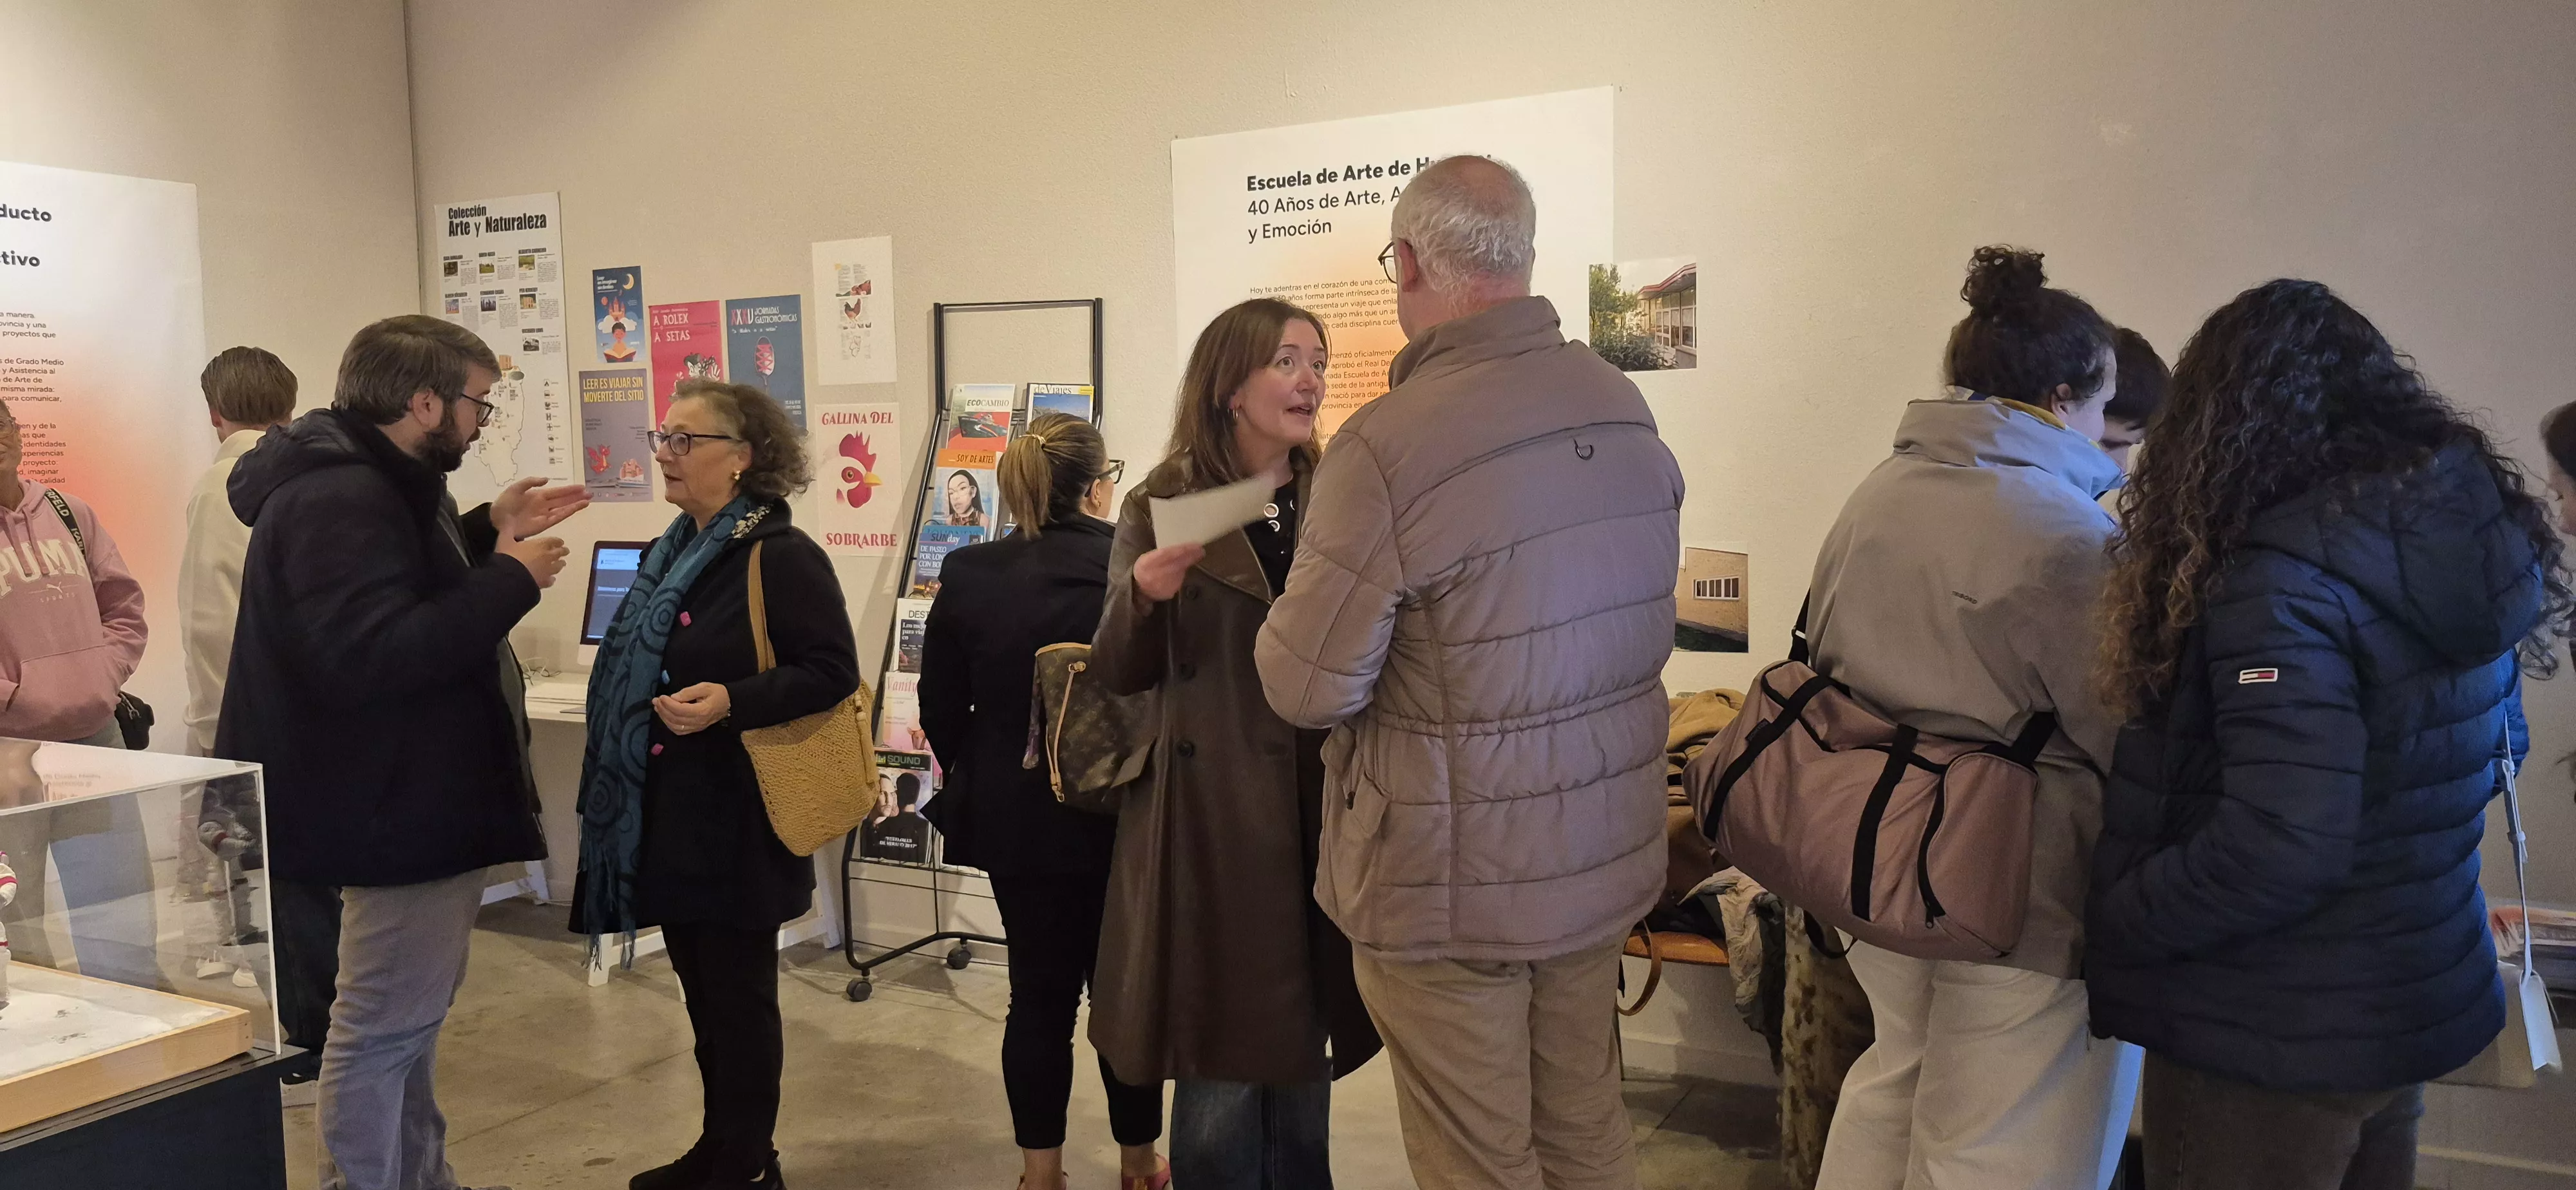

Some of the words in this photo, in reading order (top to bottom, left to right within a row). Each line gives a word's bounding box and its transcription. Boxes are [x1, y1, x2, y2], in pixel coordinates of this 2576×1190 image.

[1247, 170, 1312, 192] Escuela
[1316, 167, 1338, 184] de
[1343, 162, 1384, 182] Arte
[1388, 159, 1411, 176] de
[1247, 199, 1269, 216] 40
[1274, 195, 1314, 214] Años
[1319, 193, 1340, 209] de
[1343, 189, 1385, 207] Arte,
[448, 204, 487, 220] Colección
[448, 220, 471, 238] Arte
[474, 221, 481, 238] y
[485, 212, 547, 233] Naturaleza
[1247, 227, 1258, 244] y
[1262, 219, 1332, 239] Emoción
[0, 249, 41, 267] tivo
[1250, 287, 1264, 295] Hoy
[1273, 283, 1302, 292] adentras
[1321, 281, 1349, 289] corazón
[1305, 292, 1325, 301] forma
[1326, 292, 1344, 300] parte
[1345, 288, 1379, 298] intrínseca
[1303, 303, 1339, 311] representa
[1350, 299, 1366, 308] viaje
[653, 316, 660, 326] A
[663, 313, 689, 326] ROLEX
[1332, 311, 1347, 319] algo
[1349, 319, 1381, 328] disciplina
[654, 332, 661, 343] A
[666, 330, 690, 342] SETAS
[1331, 350, 1352, 359] menzó
[1354, 349, 1397, 358] oficialmente
[9, 366, 48, 375] Asistencia
[1331, 361, 1355, 370] aprobó
[583, 378, 599, 390] LEER
[600, 377, 608, 389] ES
[608, 377, 631, 389] VIAJAR
[632, 376, 643, 388] SIN
[1367, 381, 1388, 389] antigu
[583, 391, 613, 403] MOVERTE
[614, 390, 627, 402] DEL
[627, 389, 644, 402] SITIO
[1350, 392, 1366, 400] para
[1321, 401, 1352, 411] provincia
[821, 411, 867, 426] GALLINA
[870, 411, 894, 424] DEL
[956, 453, 969, 462] SOY
[969, 455, 978, 463] DE
[978, 455, 994, 464] ARTES
[45, 489, 70, 517] RFELD
[826, 533, 897, 549] SOBRARBE
[887, 676, 918, 697] Vanity
[887, 755, 921, 765] SOUND
